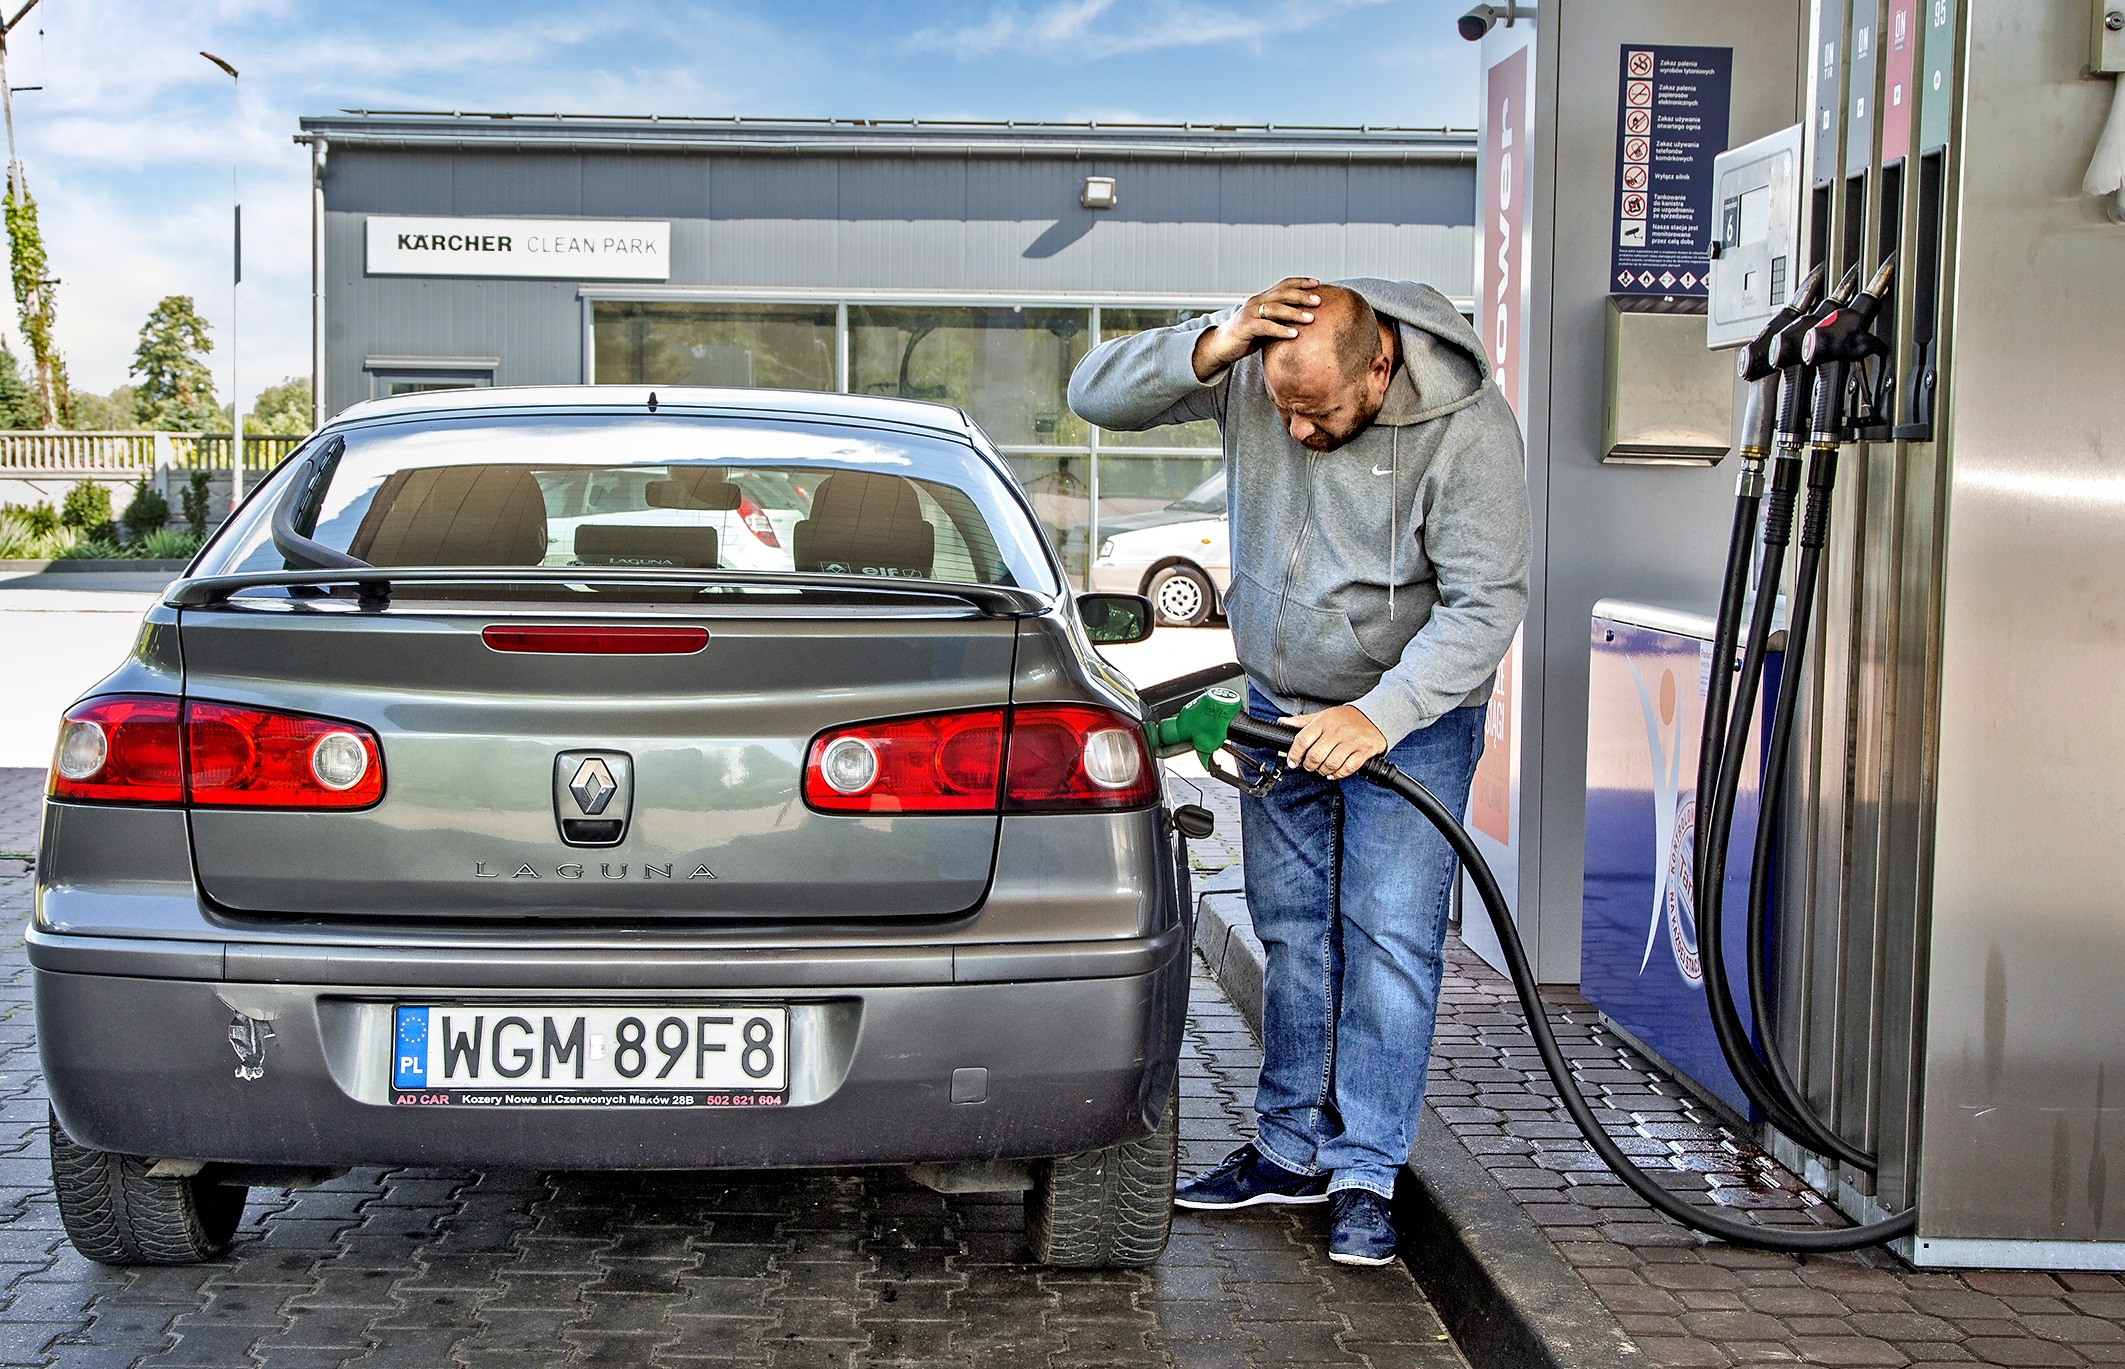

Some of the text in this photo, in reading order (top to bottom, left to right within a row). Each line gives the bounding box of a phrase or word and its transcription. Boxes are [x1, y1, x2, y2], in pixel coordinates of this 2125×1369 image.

[1934, 0, 1947, 28] 95
[1895, 10, 1907, 39] ON
[1858, 26, 1869, 53] ON
[1824, 41, 1835, 67] ON
[1684, 68, 1715, 76] tytoniowych
[1824, 67, 1834, 80] TIR
[1658, 99, 1698, 107] elektronicznych
[1657, 123, 1685, 131] otwartego
[1655, 155, 1694, 163] komórkowych
[1661, 206, 1695, 214] uzgodnieniu
[1661, 213, 1693, 221] sprzedawcą
[1726, 214, 1734, 243] 6
[398, 233, 657, 255] KÄRCHER CLEAN PARK
[609, 557, 673, 566] LAGUNA
[861, 566, 900, 577] elf
[475, 860, 718, 880] LAGUNA
[442, 1015, 774, 1080] WGM 89F8
[400, 1056, 423, 1074] PL
[396, 1094, 450, 1105] AD CAR
[461, 1094, 502, 1106] Kozery
[505, 1094, 538, 1105] Nowe
[541, 1094, 626, 1106] ul.Czerwonych
[672, 1096, 695, 1106] 28B
[707, 1095, 782, 1106] 502 621 604
